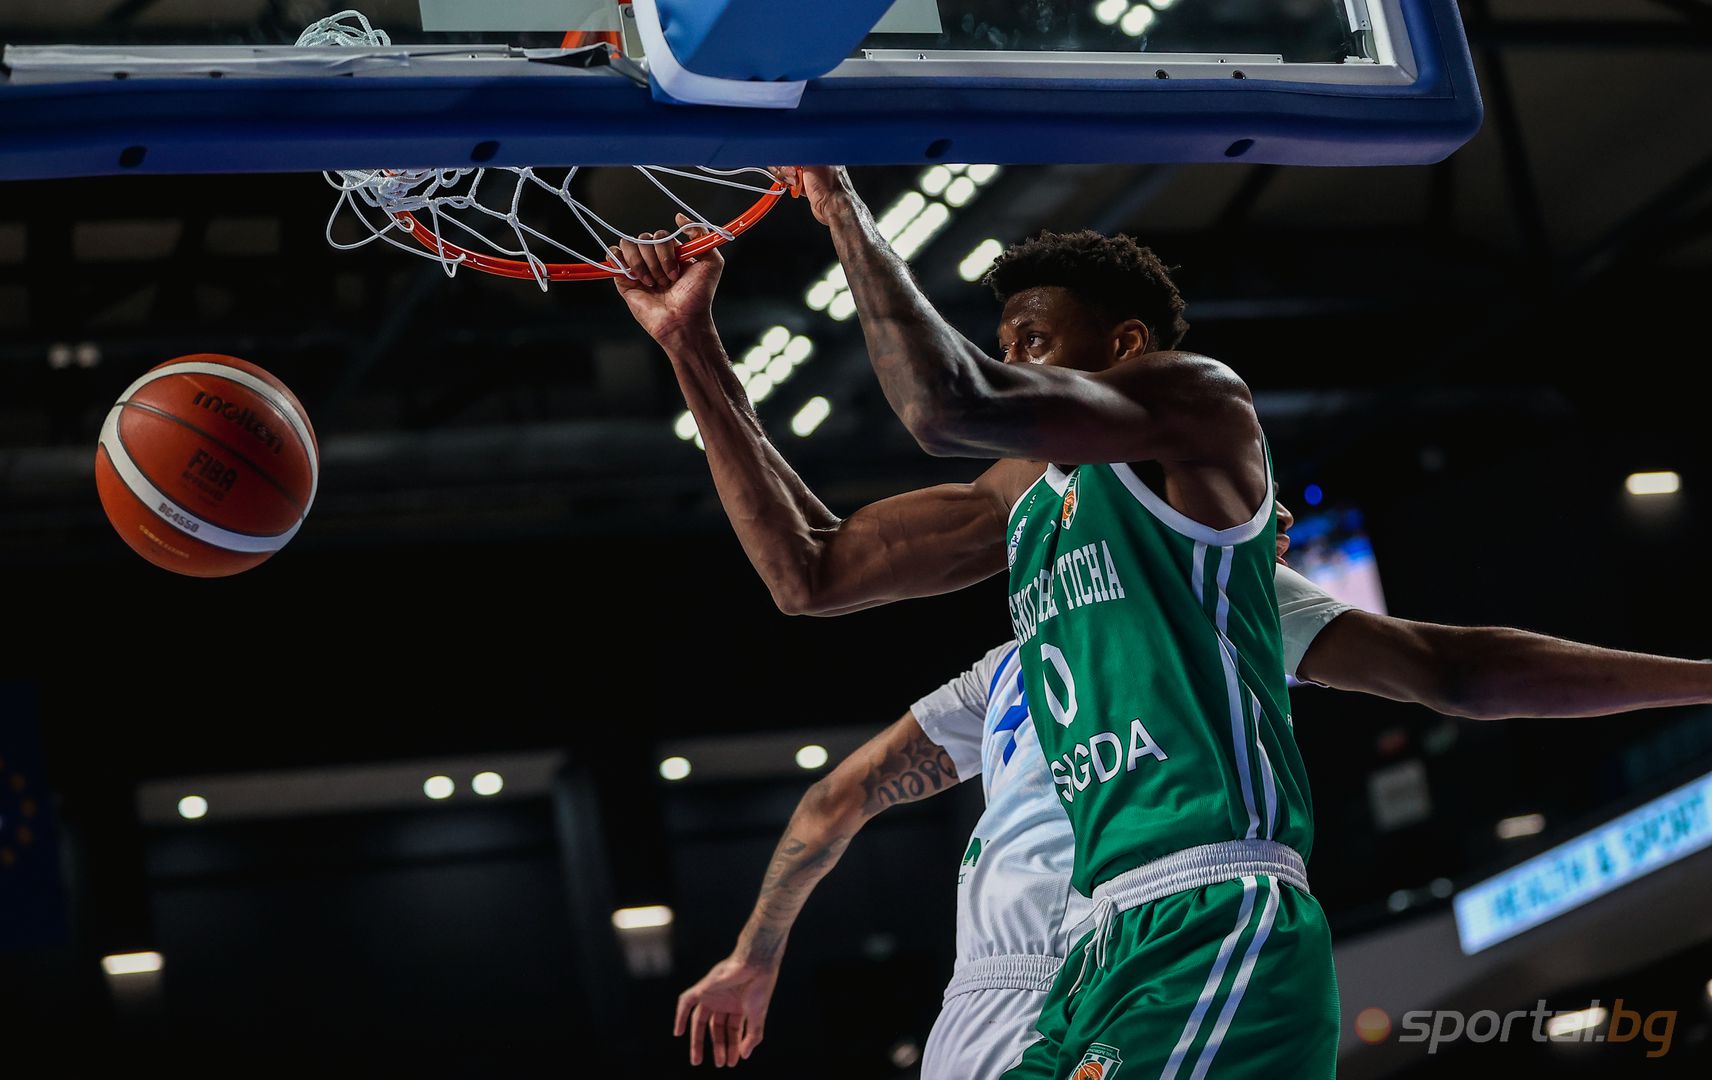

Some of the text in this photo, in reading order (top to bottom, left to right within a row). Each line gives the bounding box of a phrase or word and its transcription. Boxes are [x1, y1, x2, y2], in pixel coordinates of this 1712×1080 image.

[193, 391, 282, 455] molten
[187, 447, 238, 491] FIBA
[1056, 540, 1126, 611] TICHA
[1040, 643, 1079, 729] 0
